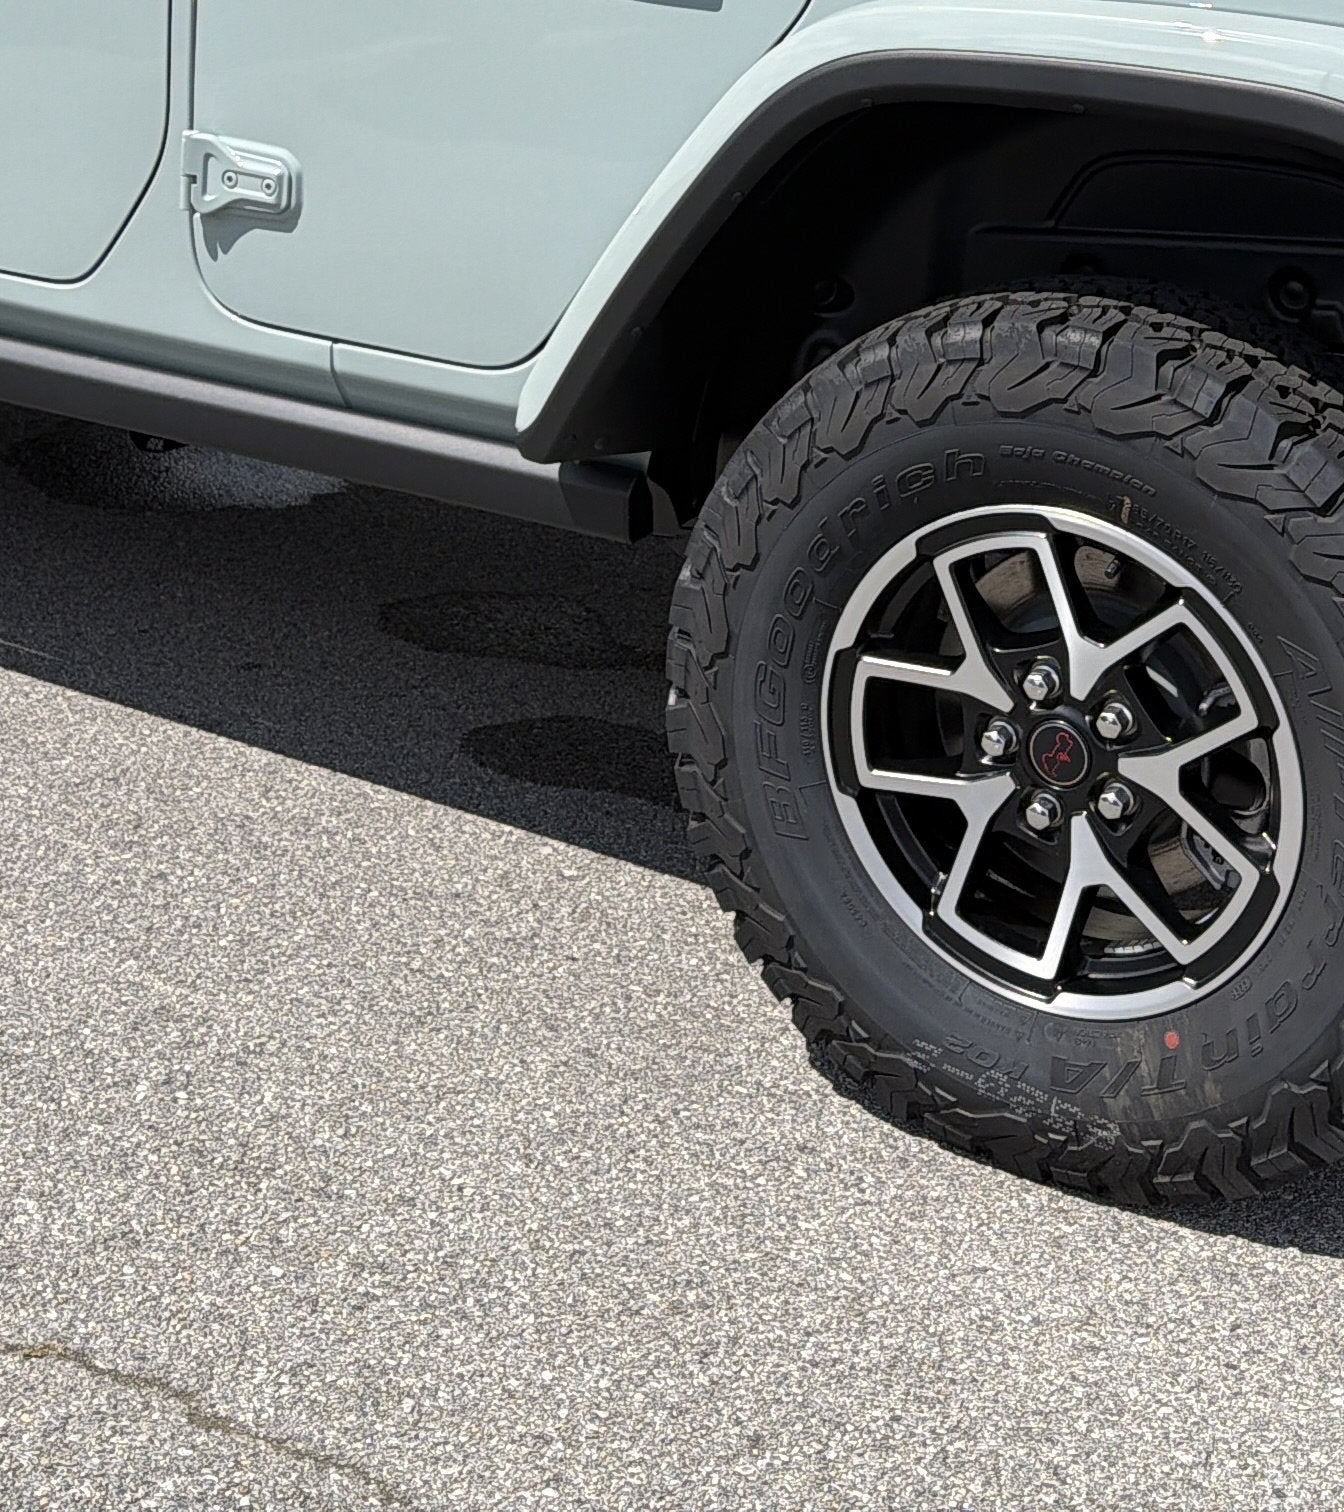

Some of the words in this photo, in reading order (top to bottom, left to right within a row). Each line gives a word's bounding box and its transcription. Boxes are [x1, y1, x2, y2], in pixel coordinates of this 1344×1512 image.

[1052, 449, 1157, 497] Champion
[753, 448, 986, 841] BFGoodrich
[943, 1034, 1031, 1080] KO2
[1049, 1054, 1187, 1098] T/A
